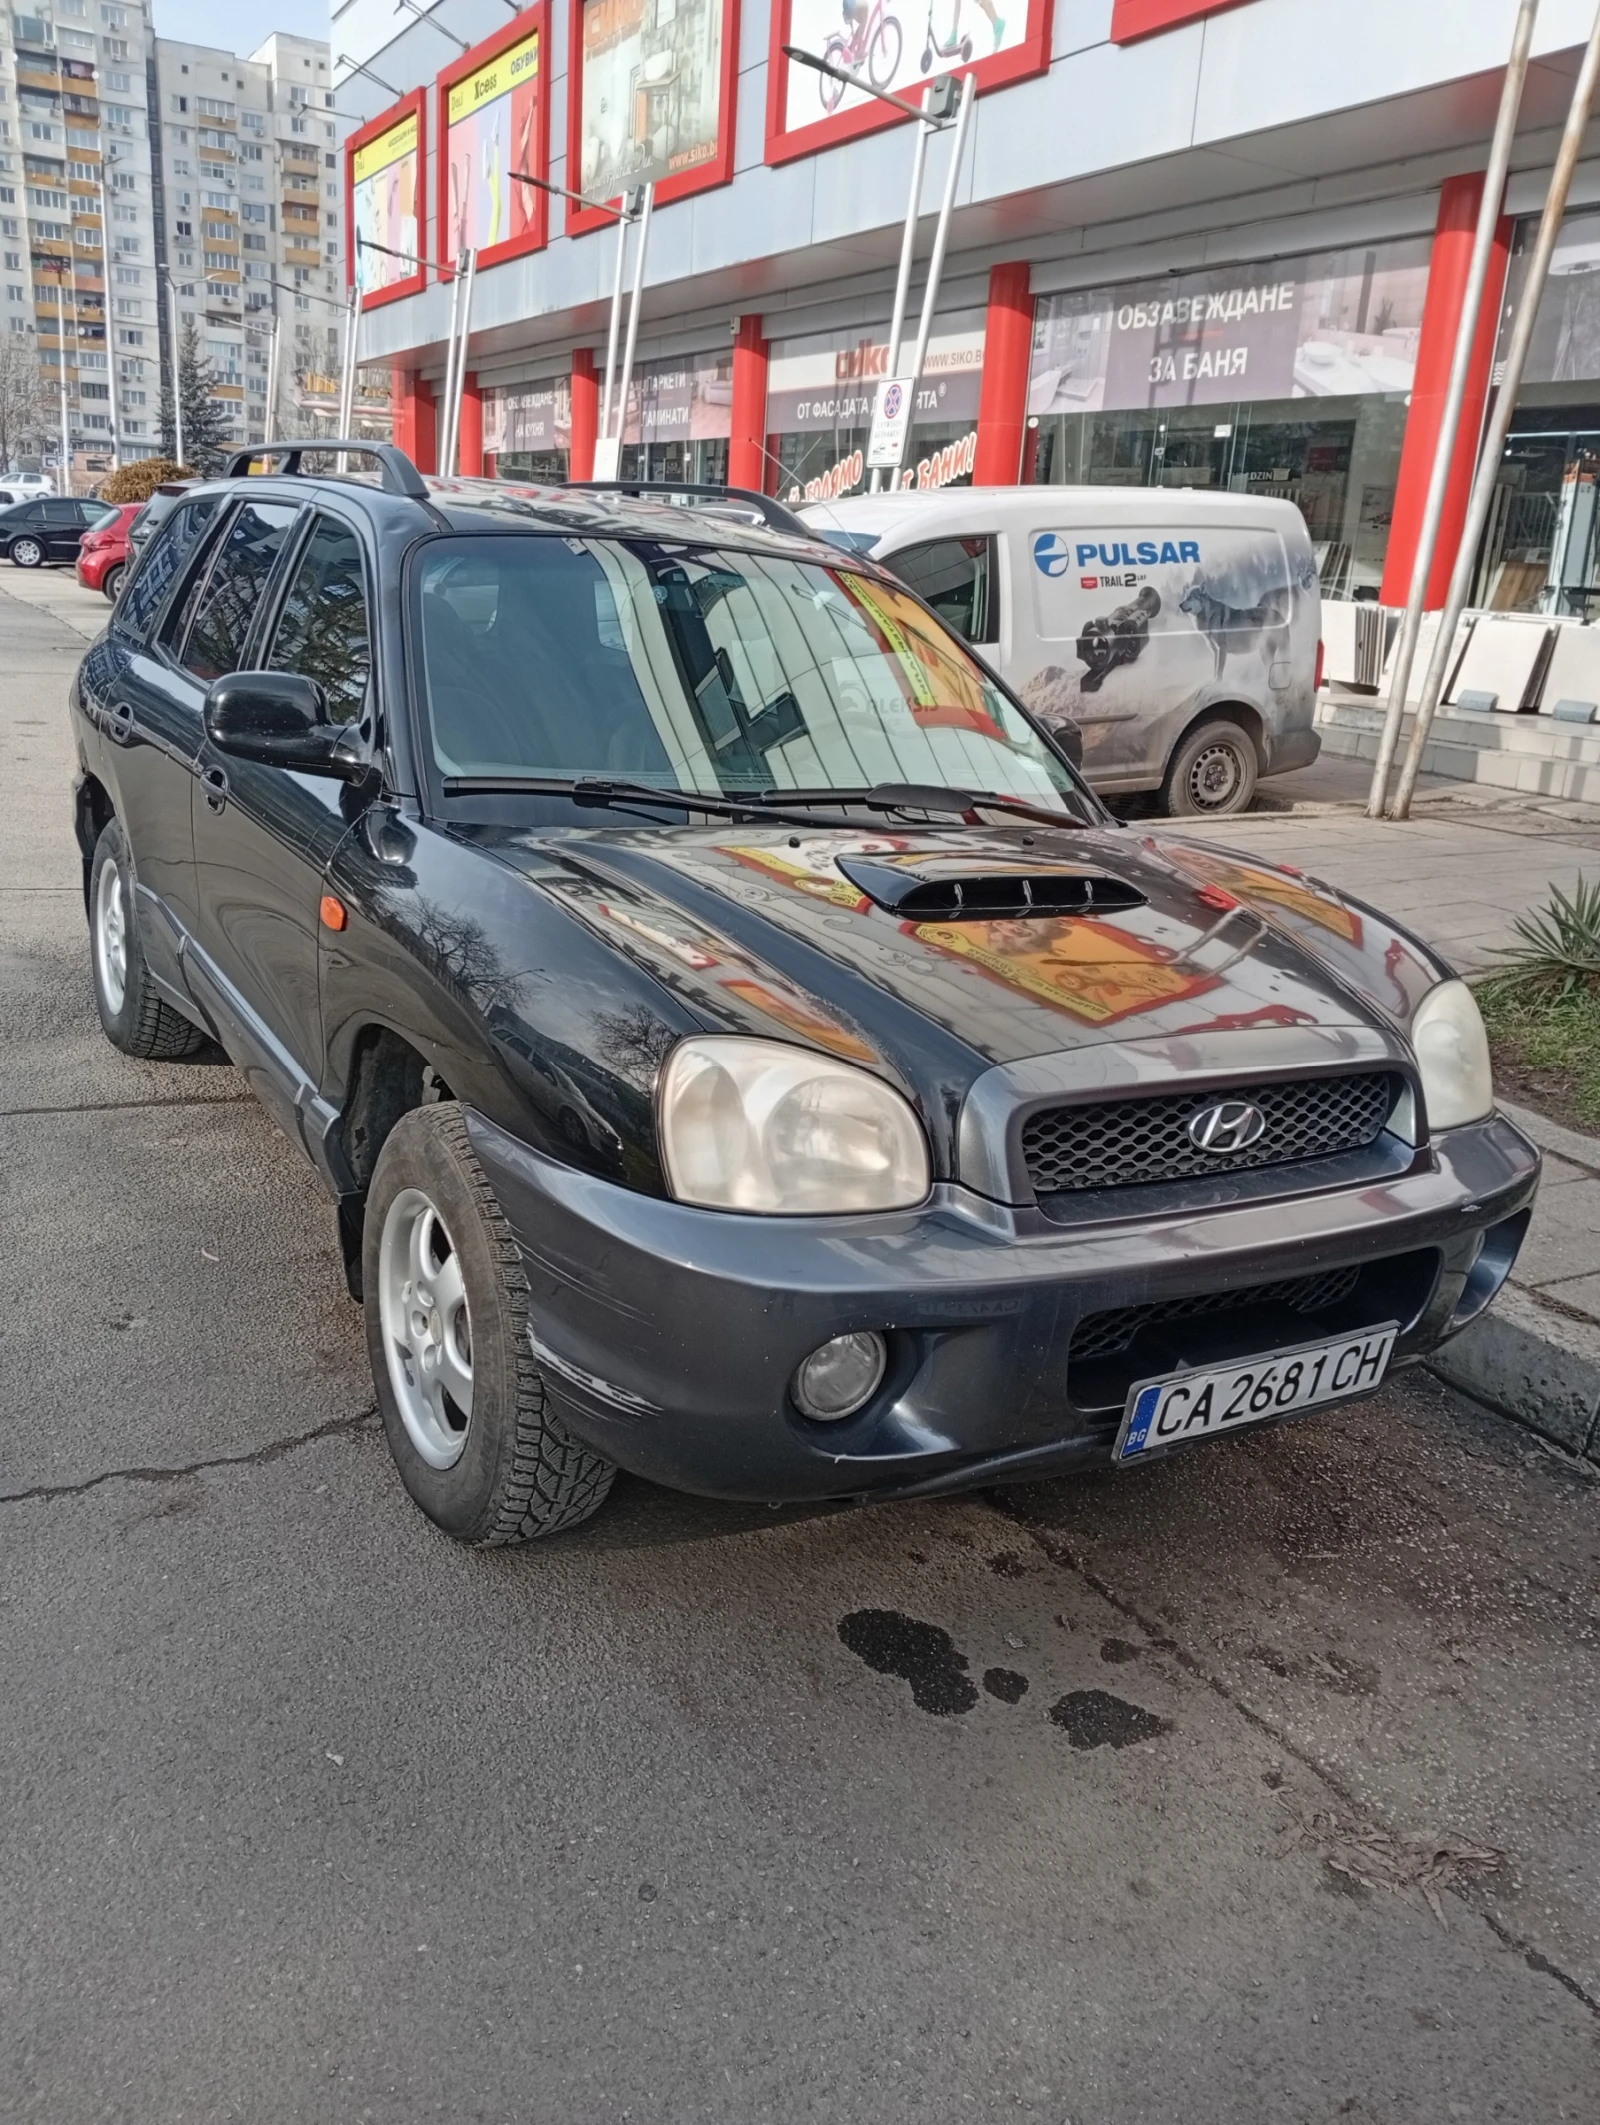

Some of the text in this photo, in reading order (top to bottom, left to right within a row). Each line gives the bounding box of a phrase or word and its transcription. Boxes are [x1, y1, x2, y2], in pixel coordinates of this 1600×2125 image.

[1118, 281, 1295, 331] ОБЗАВЕЖДАНЕ
[924, 349, 984, 368] WWW.SIKO.B
[1148, 347, 1248, 383] ЗА БАНЯ
[797, 403, 811, 419] ОТ
[813, 398, 868, 419] ФАСАДАТА
[1076, 541, 1200, 567] PULSAR
[1099, 576, 1124, 588] TRAIL
[1157, 1337, 1388, 1437] CA 2681 CH
[1127, 1429, 1146, 1446] BG
